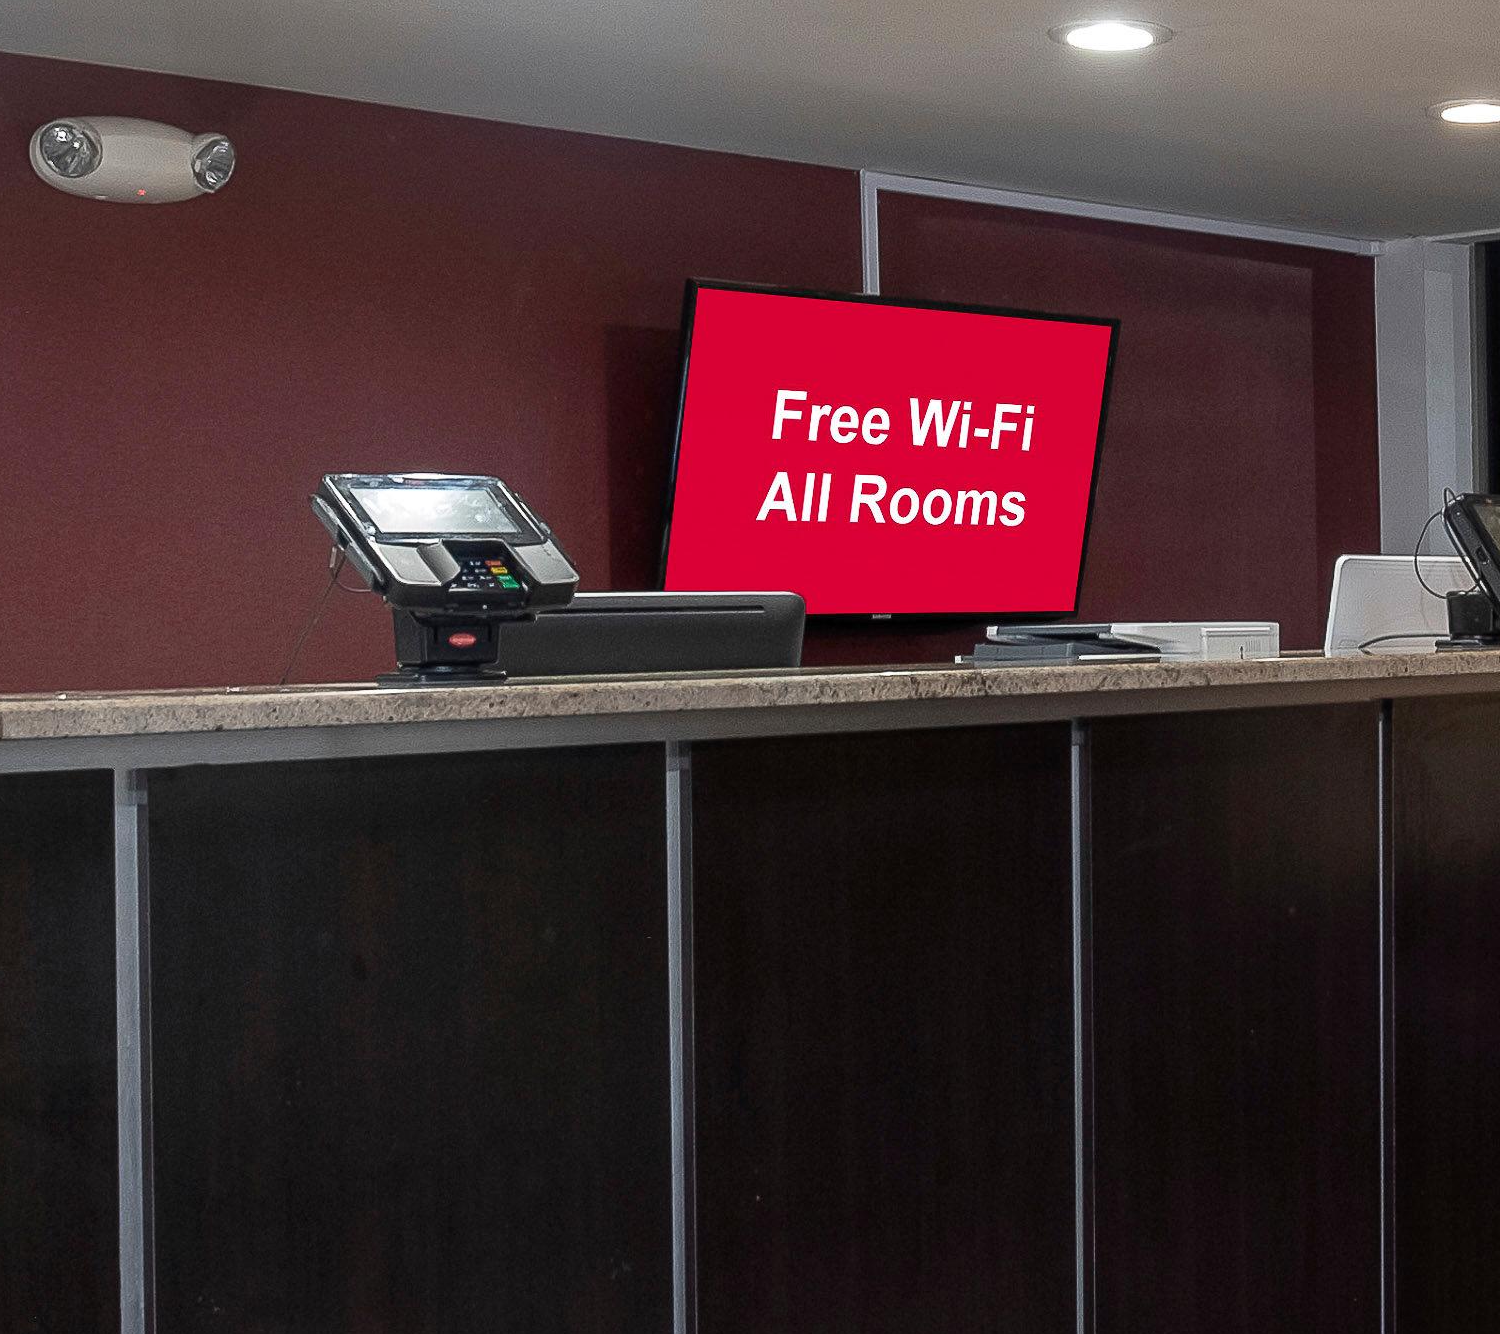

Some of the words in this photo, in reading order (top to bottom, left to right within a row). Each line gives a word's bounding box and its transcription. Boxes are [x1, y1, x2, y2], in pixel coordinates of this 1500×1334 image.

[771, 389, 891, 446] Free
[908, 397, 1036, 452] Wi-Fi
[755, 471, 832, 523] All
[849, 474, 1026, 527] Rooms
